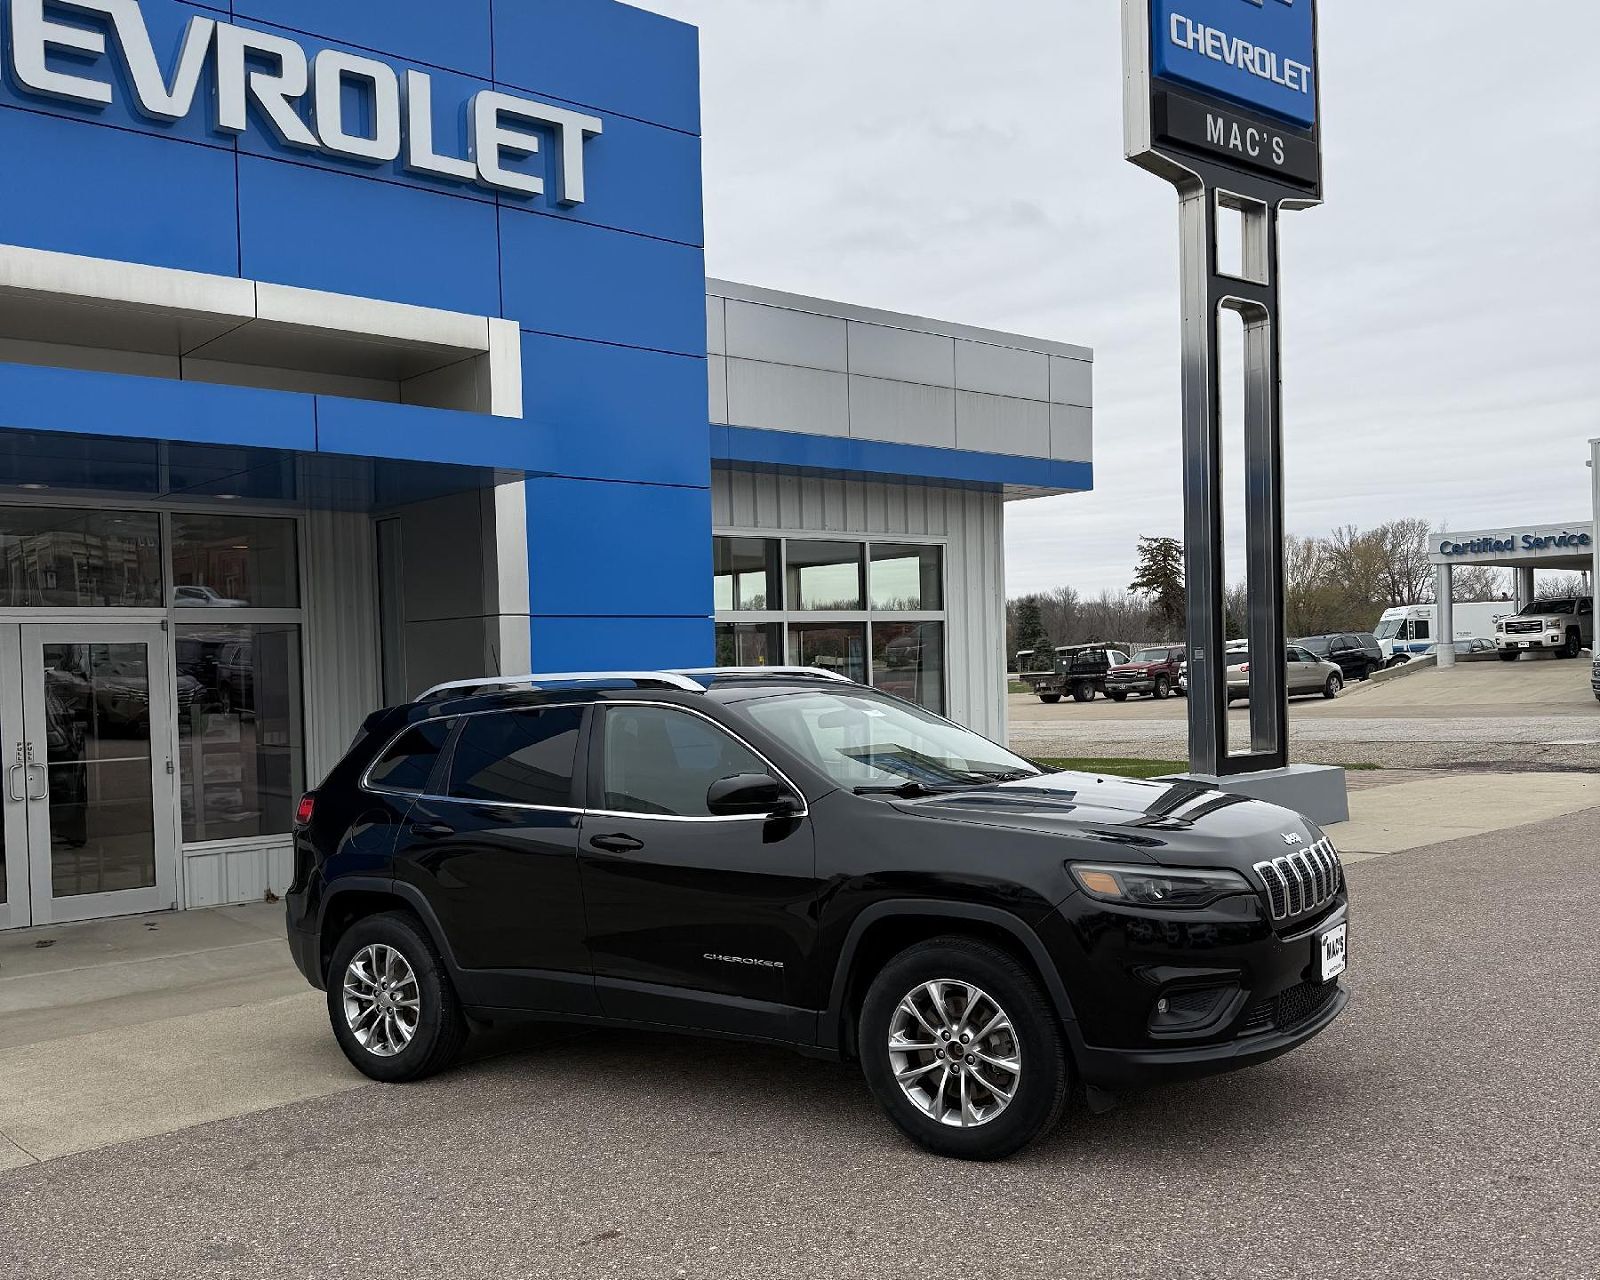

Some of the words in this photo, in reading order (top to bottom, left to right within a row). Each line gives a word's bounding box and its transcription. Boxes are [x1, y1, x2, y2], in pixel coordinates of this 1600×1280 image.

[1170, 12, 1311, 94] CHEVROLET
[1206, 113, 1285, 165] MAC'S
[1439, 535, 1515, 556] Certified
[1521, 531, 1590, 551] Service
[703, 953, 784, 968] CHEROKEE
